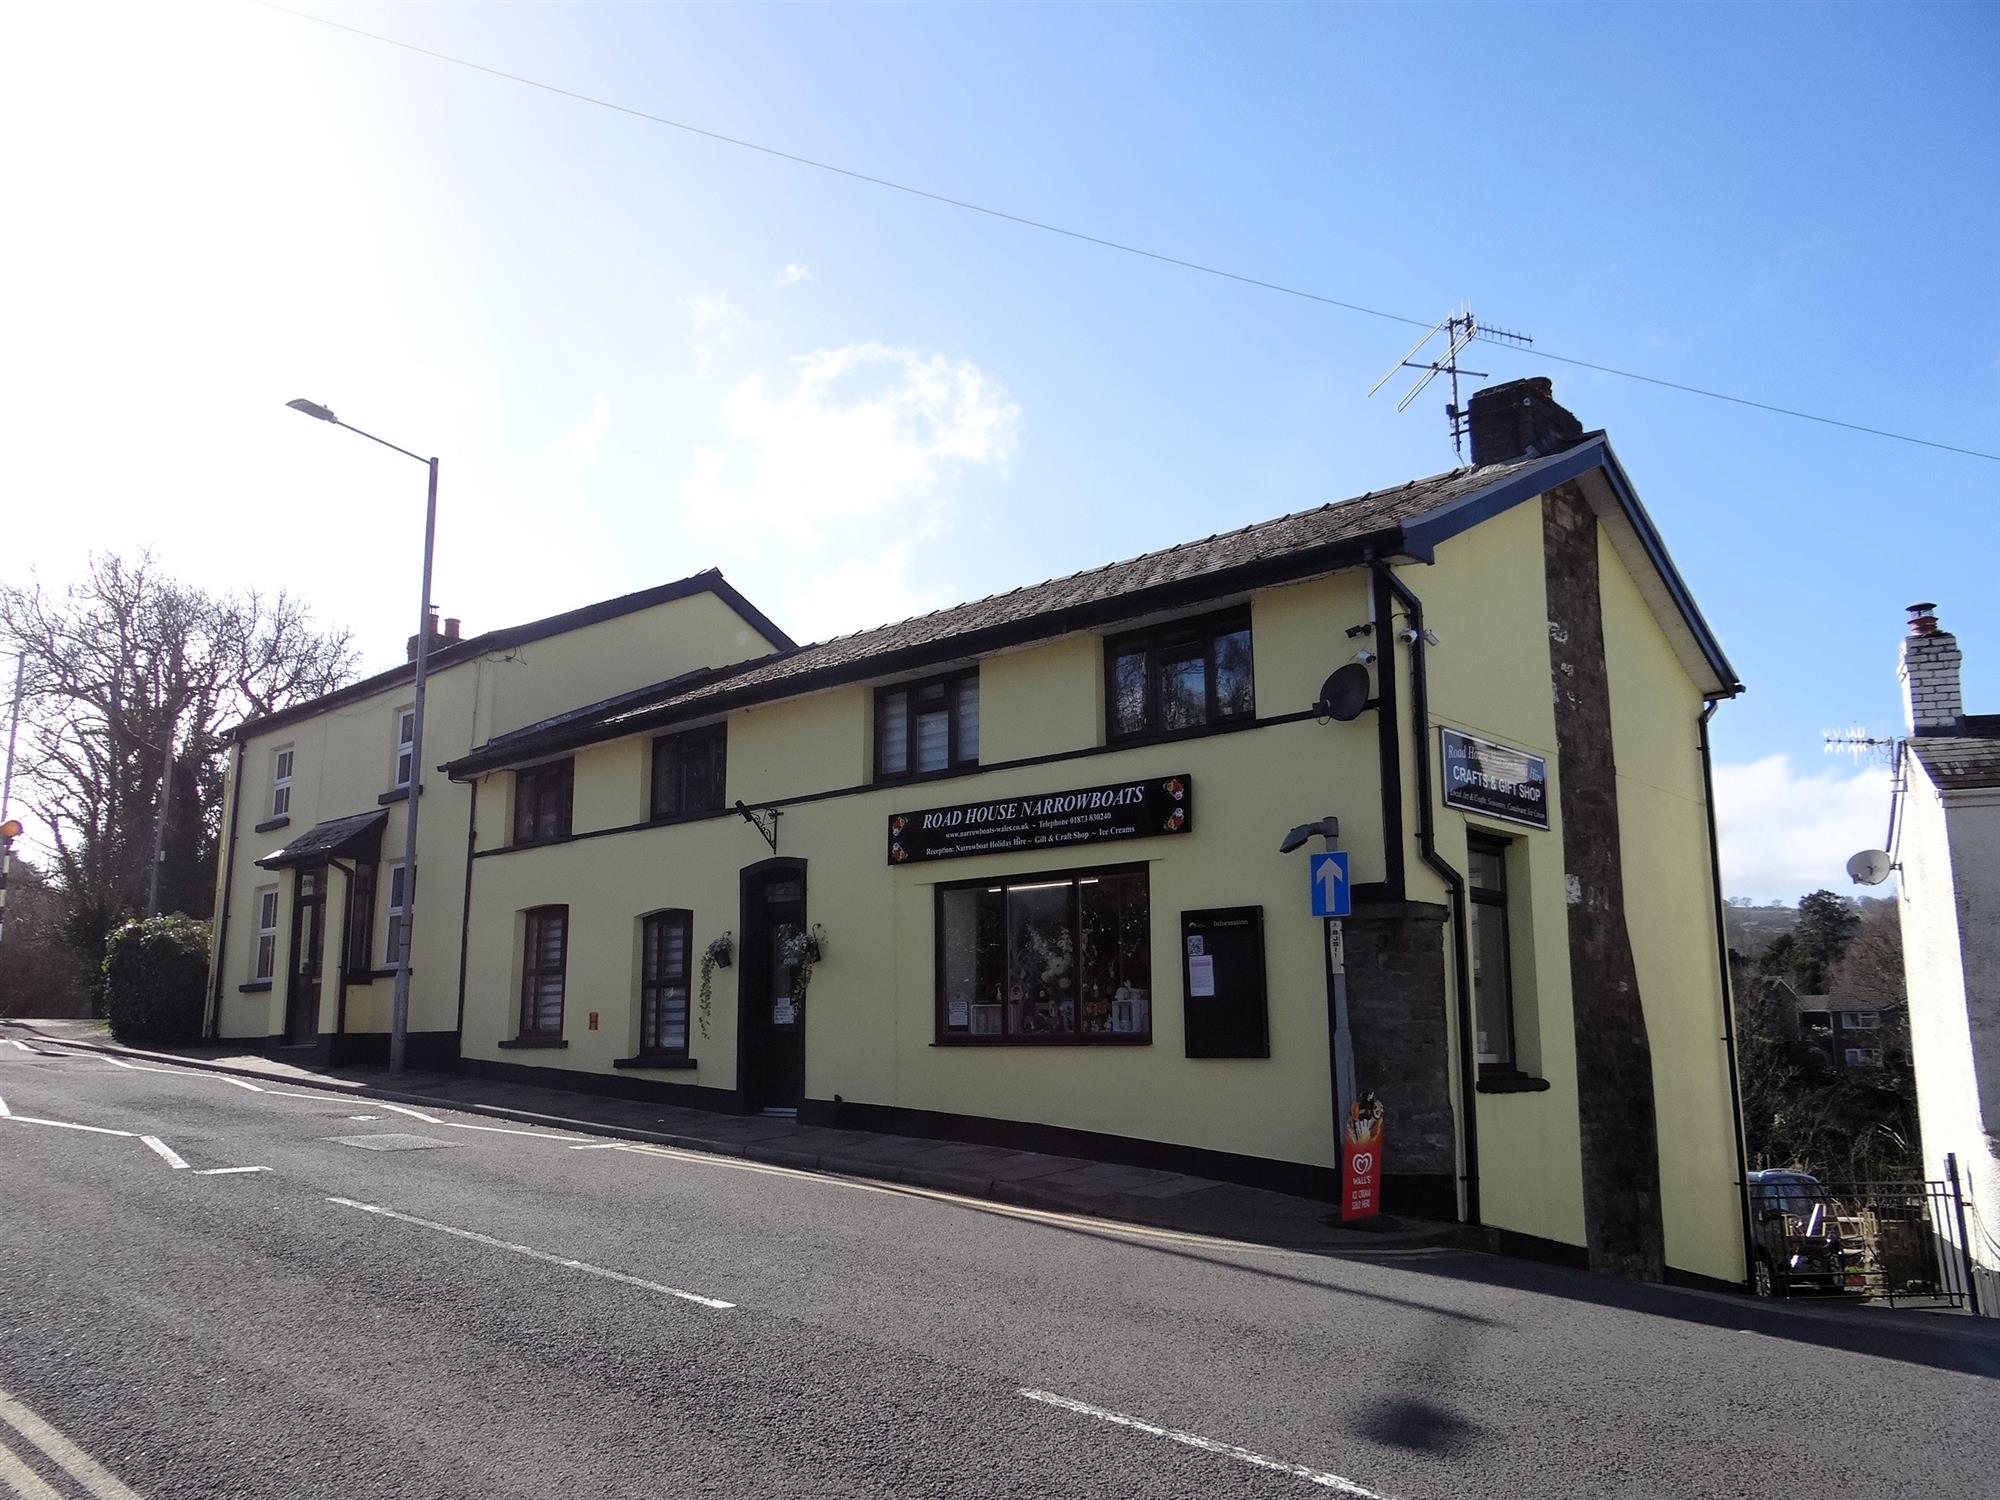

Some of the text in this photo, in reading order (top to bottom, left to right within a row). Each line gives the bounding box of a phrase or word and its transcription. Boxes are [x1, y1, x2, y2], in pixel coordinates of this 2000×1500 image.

[1448, 744, 1466, 759] Road
[1453, 765, 1488, 788] CRAFTS
[1490, 776, 1497, 791] &
[1498, 779, 1517, 796] GIFT
[1518, 784, 1541, 802] SHOP
[922, 786, 1145, 829] ROAD HOUSE NARROWBOATS
[926, 847, 954, 856] Reception:
[955, 841, 989, 852] Narrowboat
[989, 838, 1012, 849] Holiday
[1013, 837, 1027, 846] Hire
[1034, 834, 1047, 844] Gift
[1048, 834, 1054, 842] &
[1055, 832, 1072, 841] Craft
[1073, 830, 1089, 840] Shop
[1099, 827, 1109, 836] Ice
[1110, 825, 1135, 836] Creams
[945, 822, 1029, 838] www.narrowboats-wales.co.uk
[1039, 817, 1068, 829] Telephone
[1069, 815, 1088, 825] 01873
